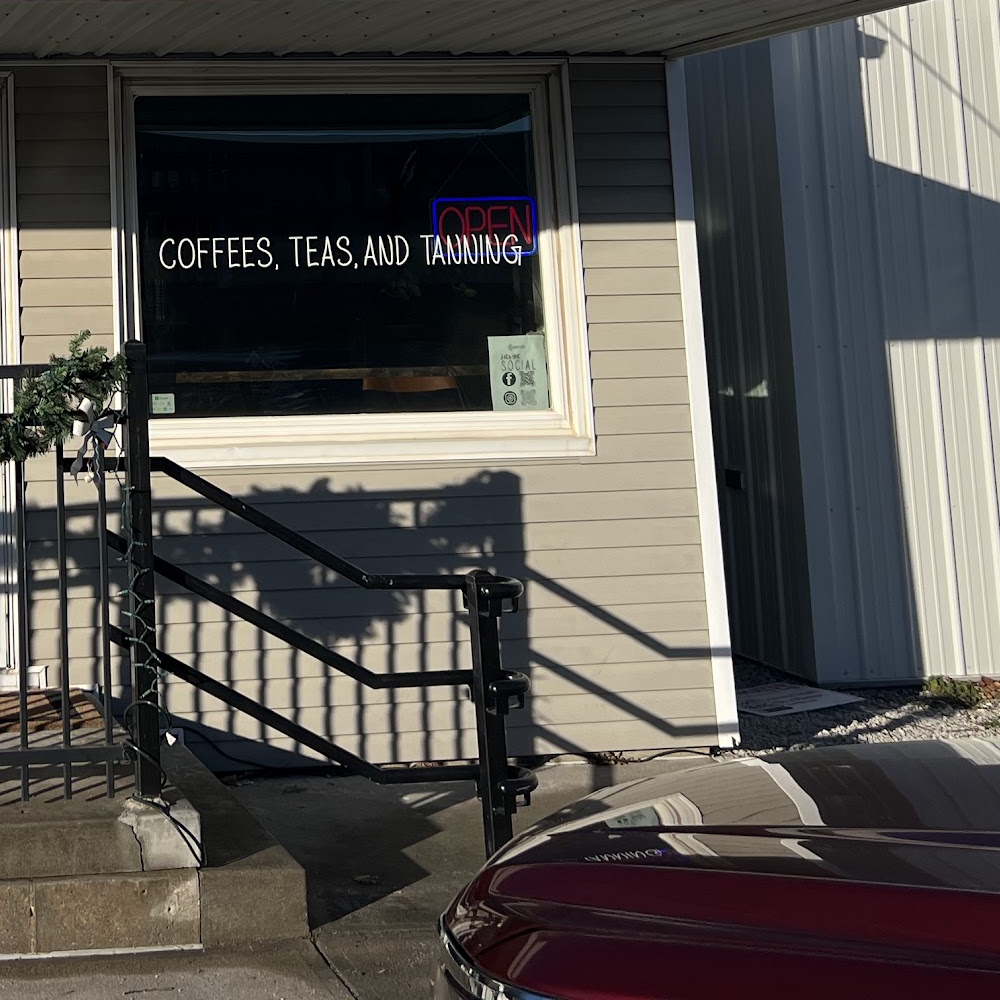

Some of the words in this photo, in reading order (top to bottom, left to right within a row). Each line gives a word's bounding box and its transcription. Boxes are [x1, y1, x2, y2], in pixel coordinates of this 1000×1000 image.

[438, 205, 532, 249] OPEN
[159, 236, 279, 270] COFFEES,
[289, 235, 359, 269] TEAS,
[364, 234, 410, 267] AND
[419, 233, 523, 266] TANNING
[501, 359, 537, 371] SOCIAL
